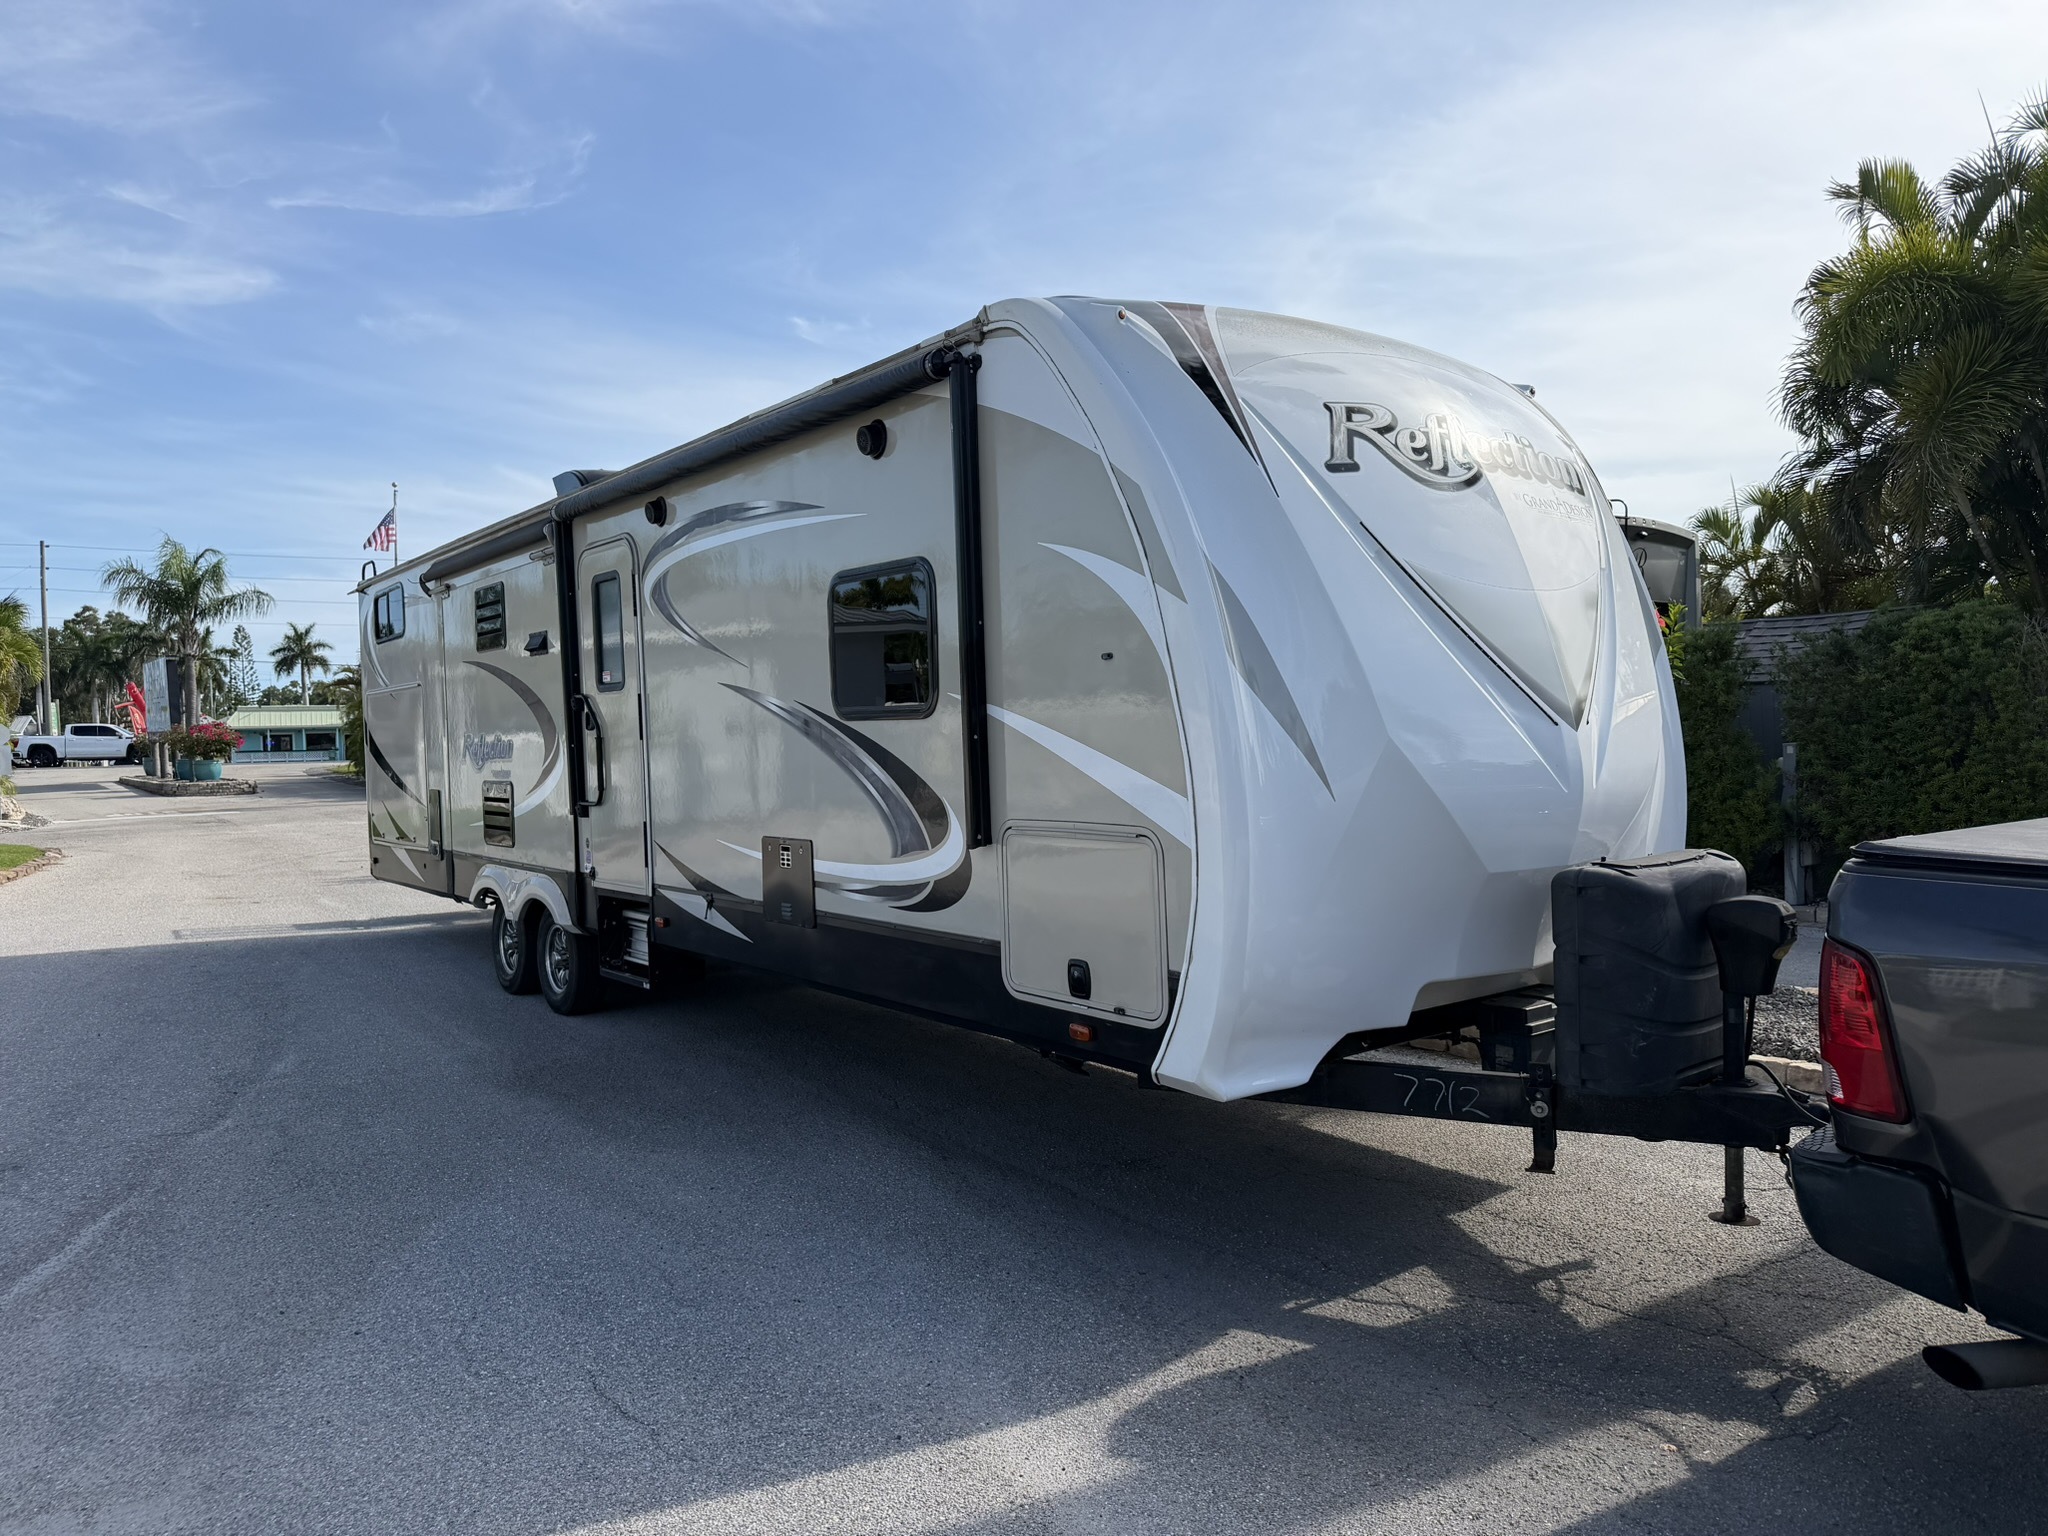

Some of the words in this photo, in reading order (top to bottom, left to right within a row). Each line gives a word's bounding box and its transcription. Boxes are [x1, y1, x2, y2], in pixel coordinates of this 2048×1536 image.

[1323, 401, 1585, 496] Reflection
[1522, 493, 1559, 511] GRAND
[461, 732, 514, 771] Reflection
[1393, 1072, 1490, 1118] 7712
